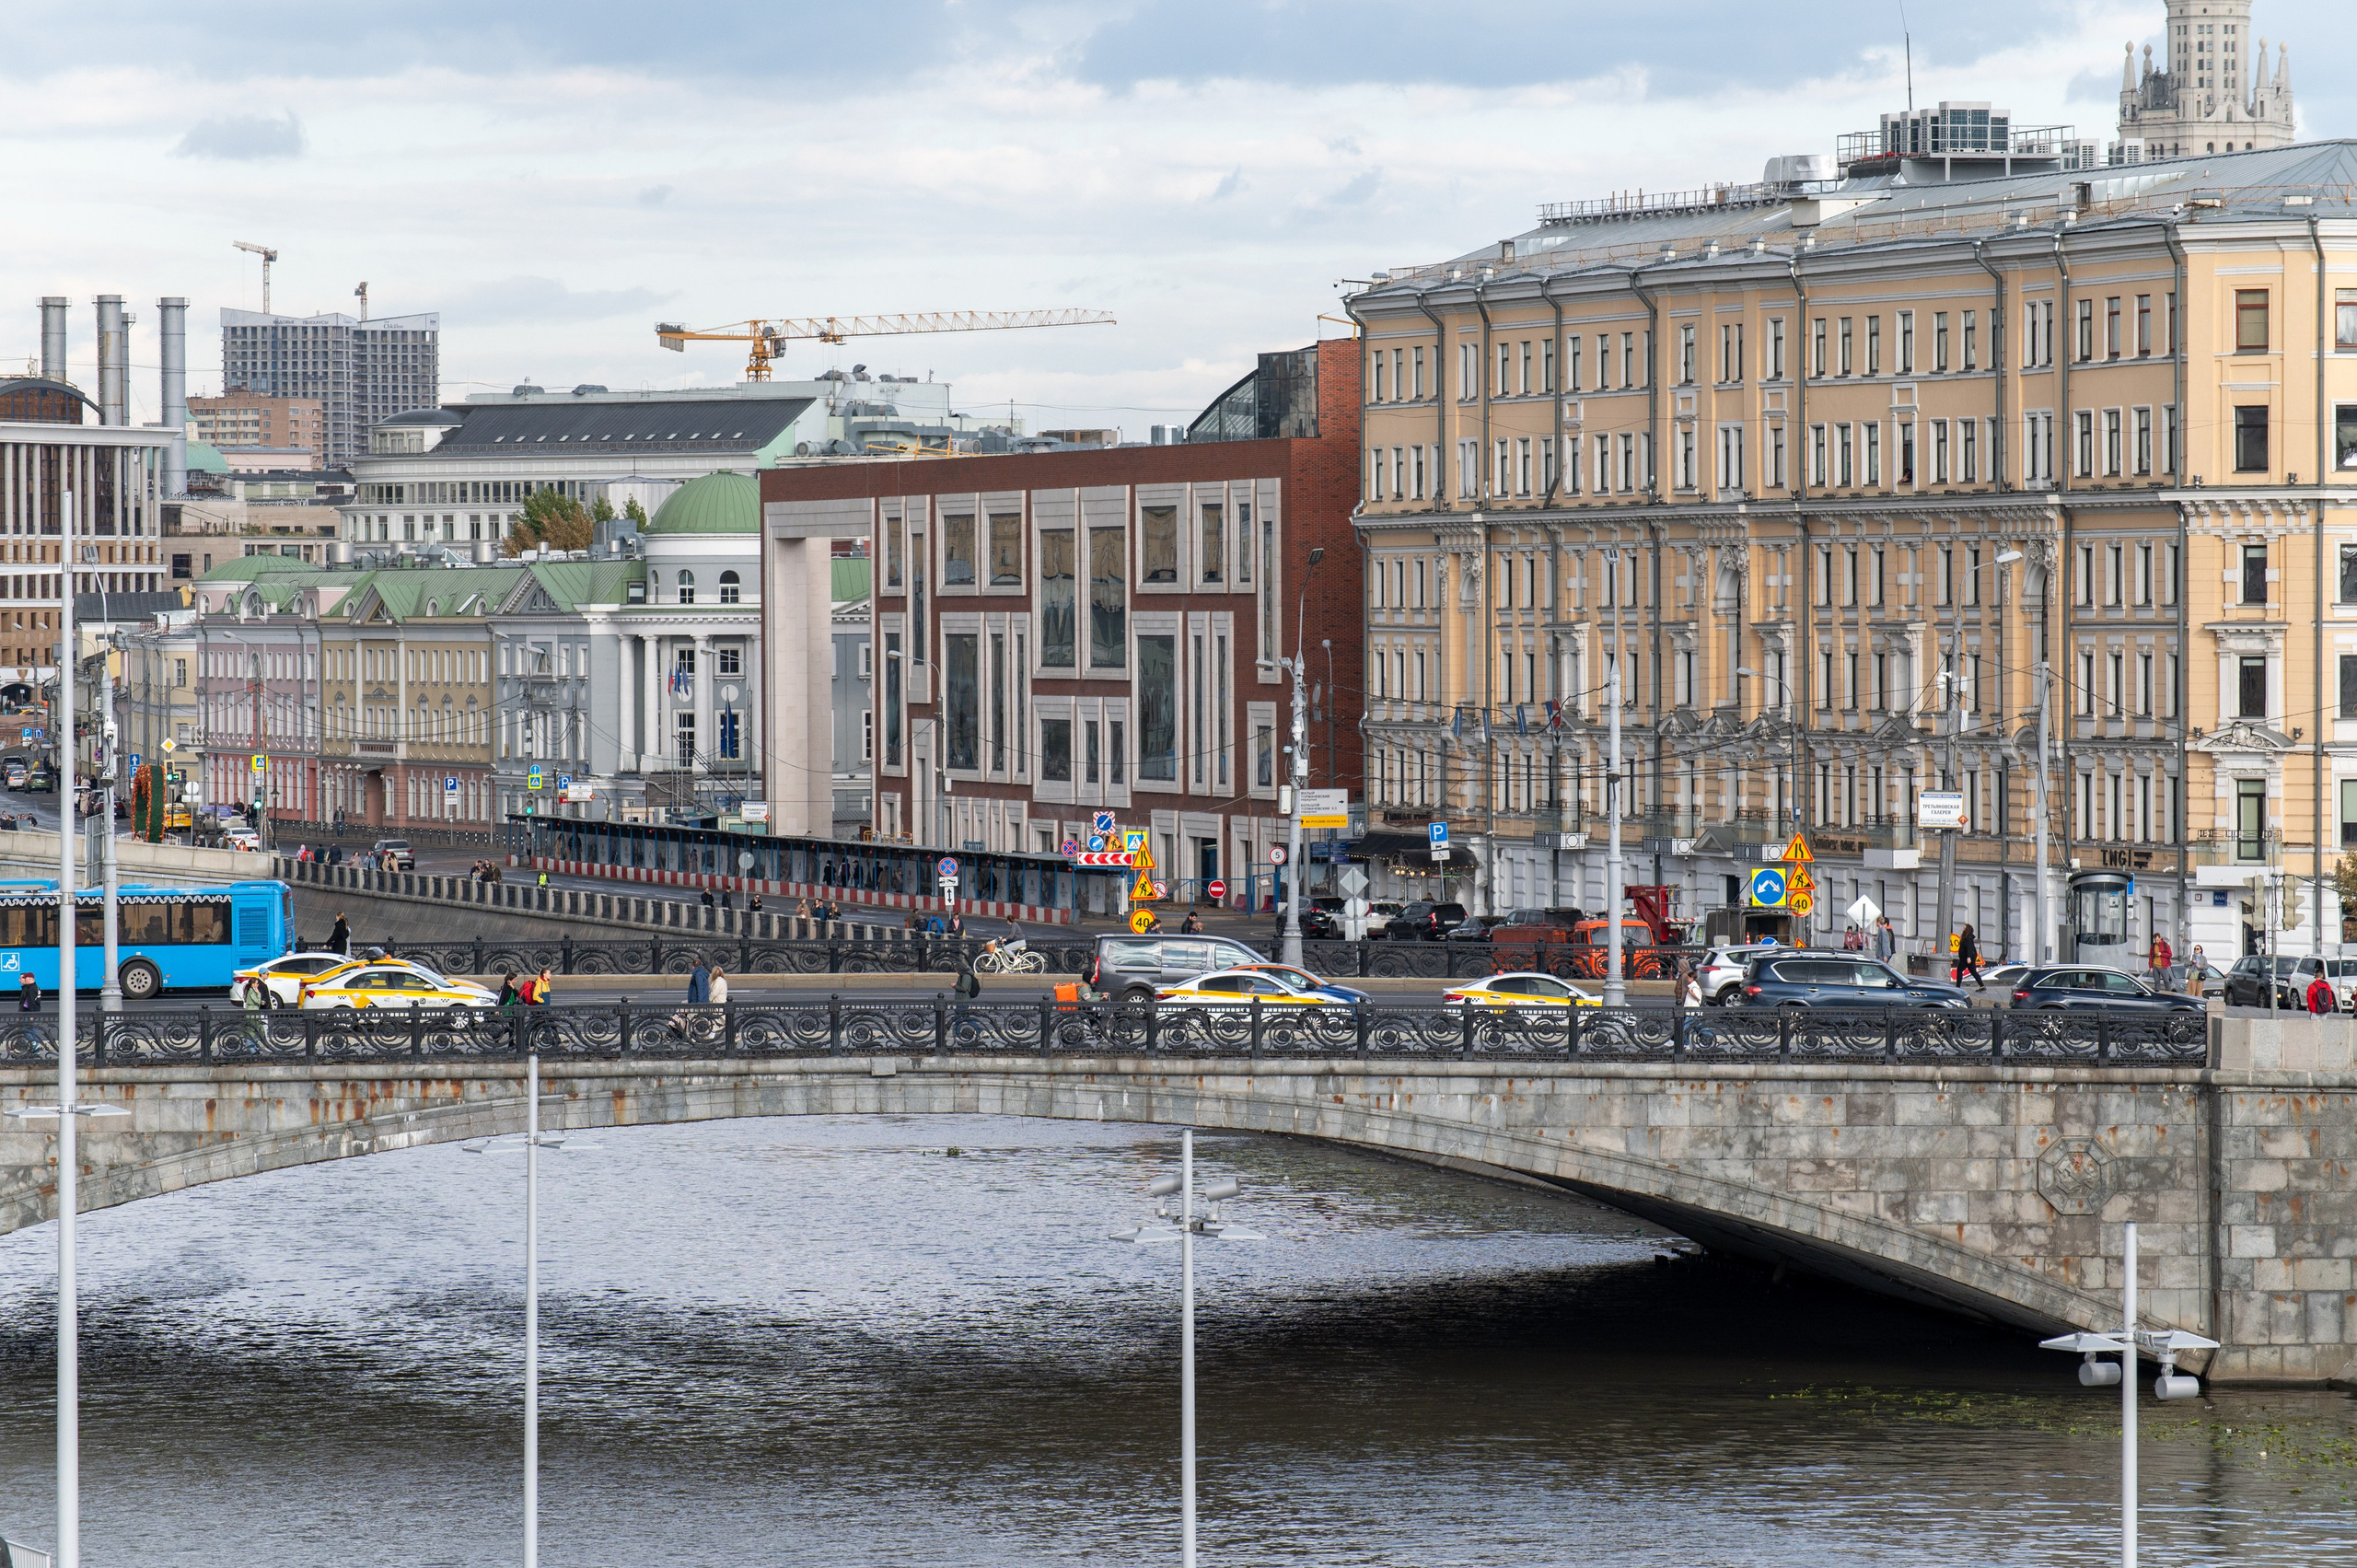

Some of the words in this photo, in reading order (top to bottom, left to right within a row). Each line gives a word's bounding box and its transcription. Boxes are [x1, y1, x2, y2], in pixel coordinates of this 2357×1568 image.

[1434, 825, 1444, 840] P
[1794, 899, 1807, 909] 40
[1135, 917, 1149, 927] 40
